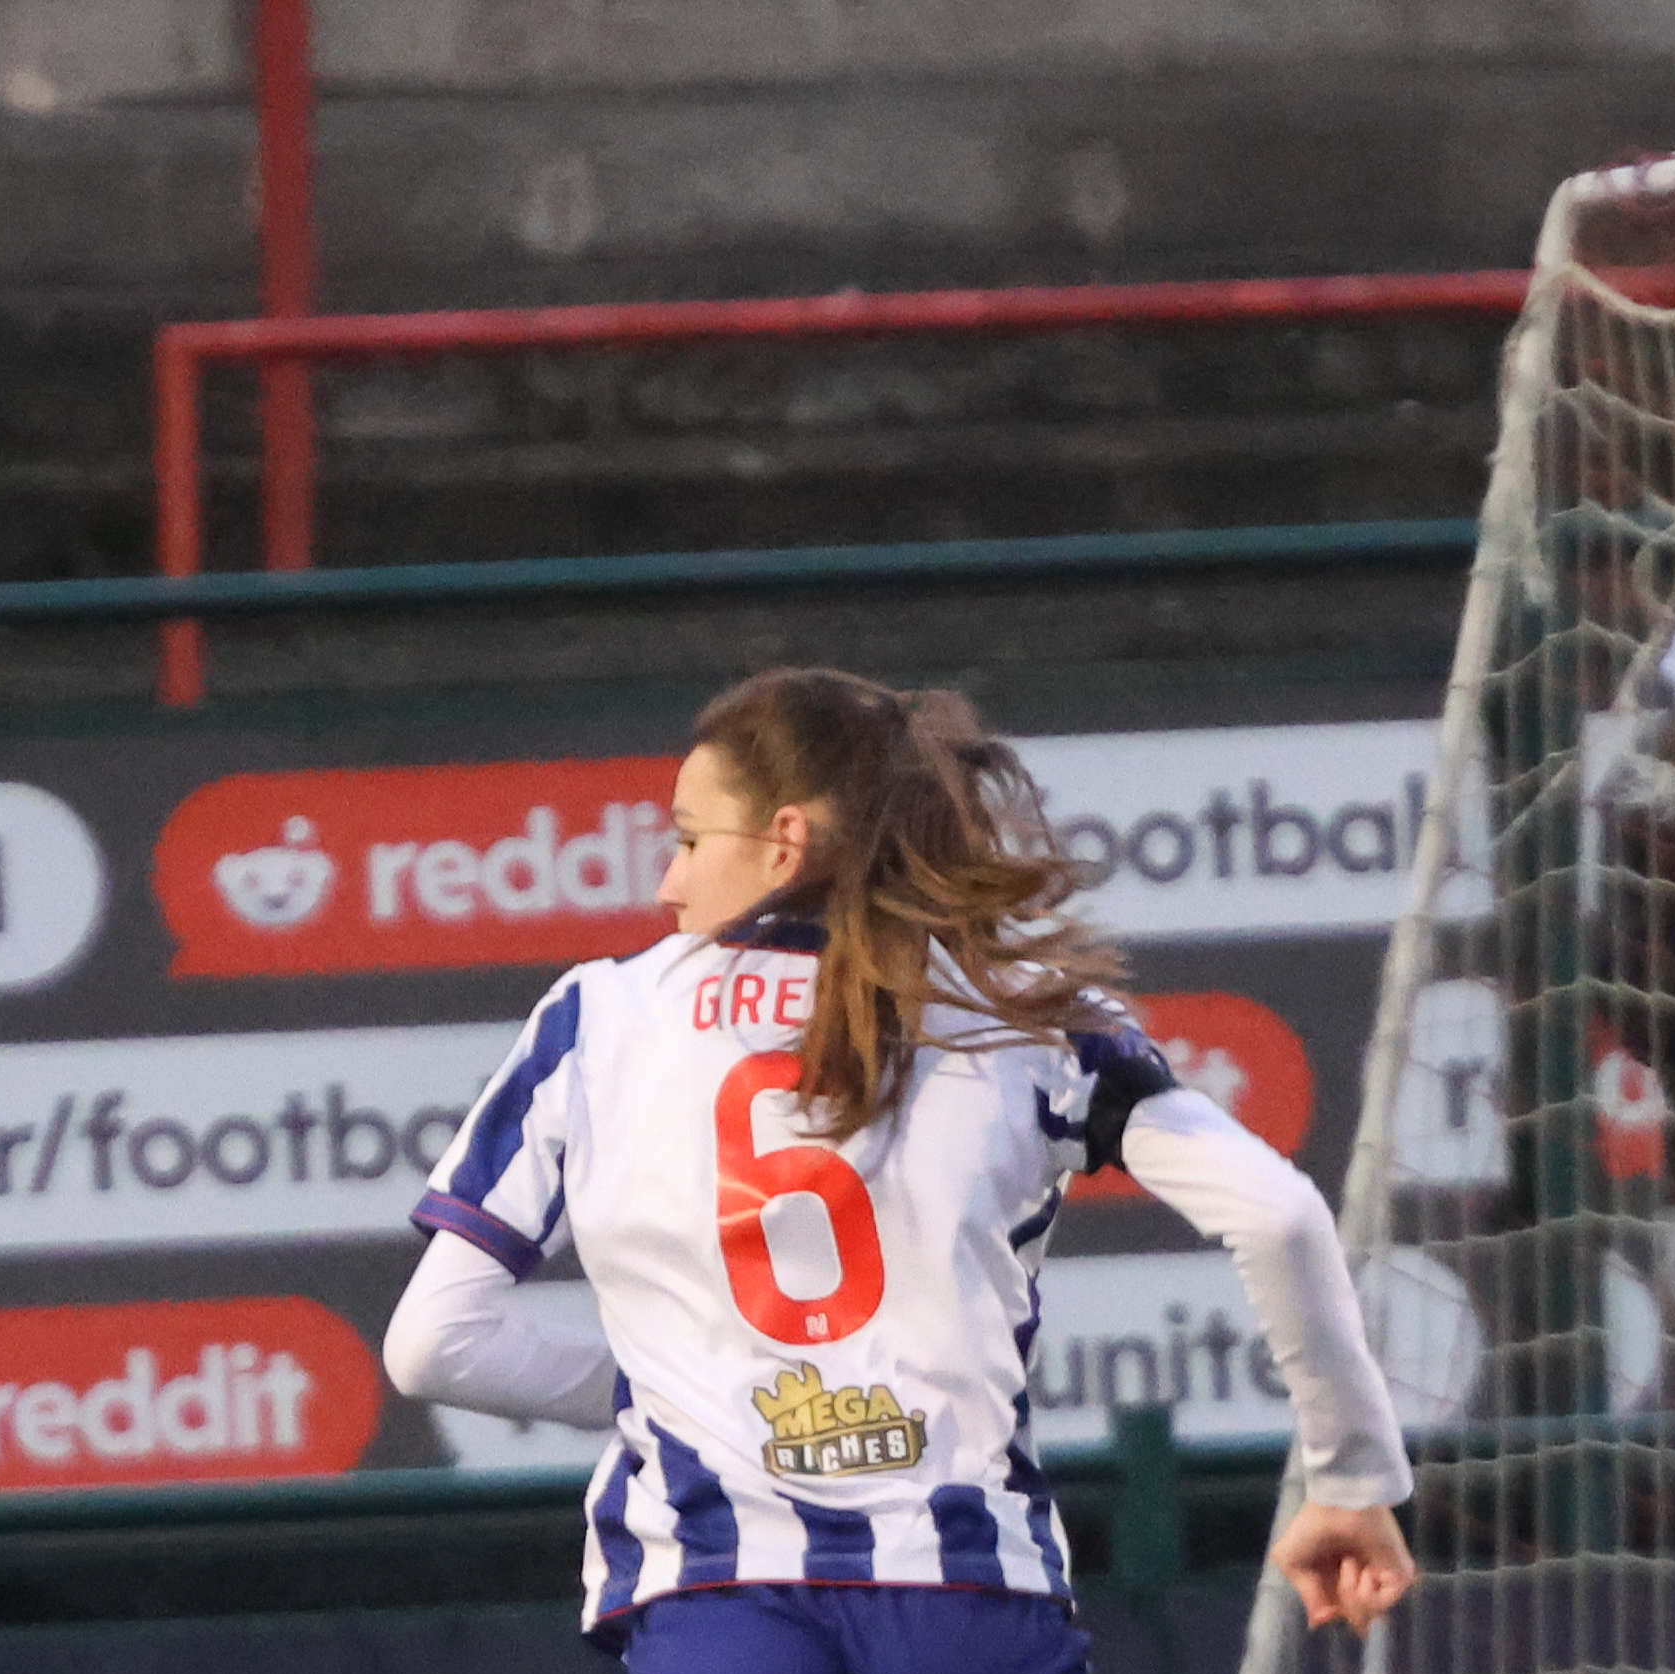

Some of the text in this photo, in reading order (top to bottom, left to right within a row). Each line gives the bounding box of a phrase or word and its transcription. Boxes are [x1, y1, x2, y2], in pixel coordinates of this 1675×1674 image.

[692, 972, 810, 1032] GRE
[715, 1049, 886, 1346] 6
[773, 1383, 904, 1438] MEGA
[777, 1428, 908, 1474] RICHES
